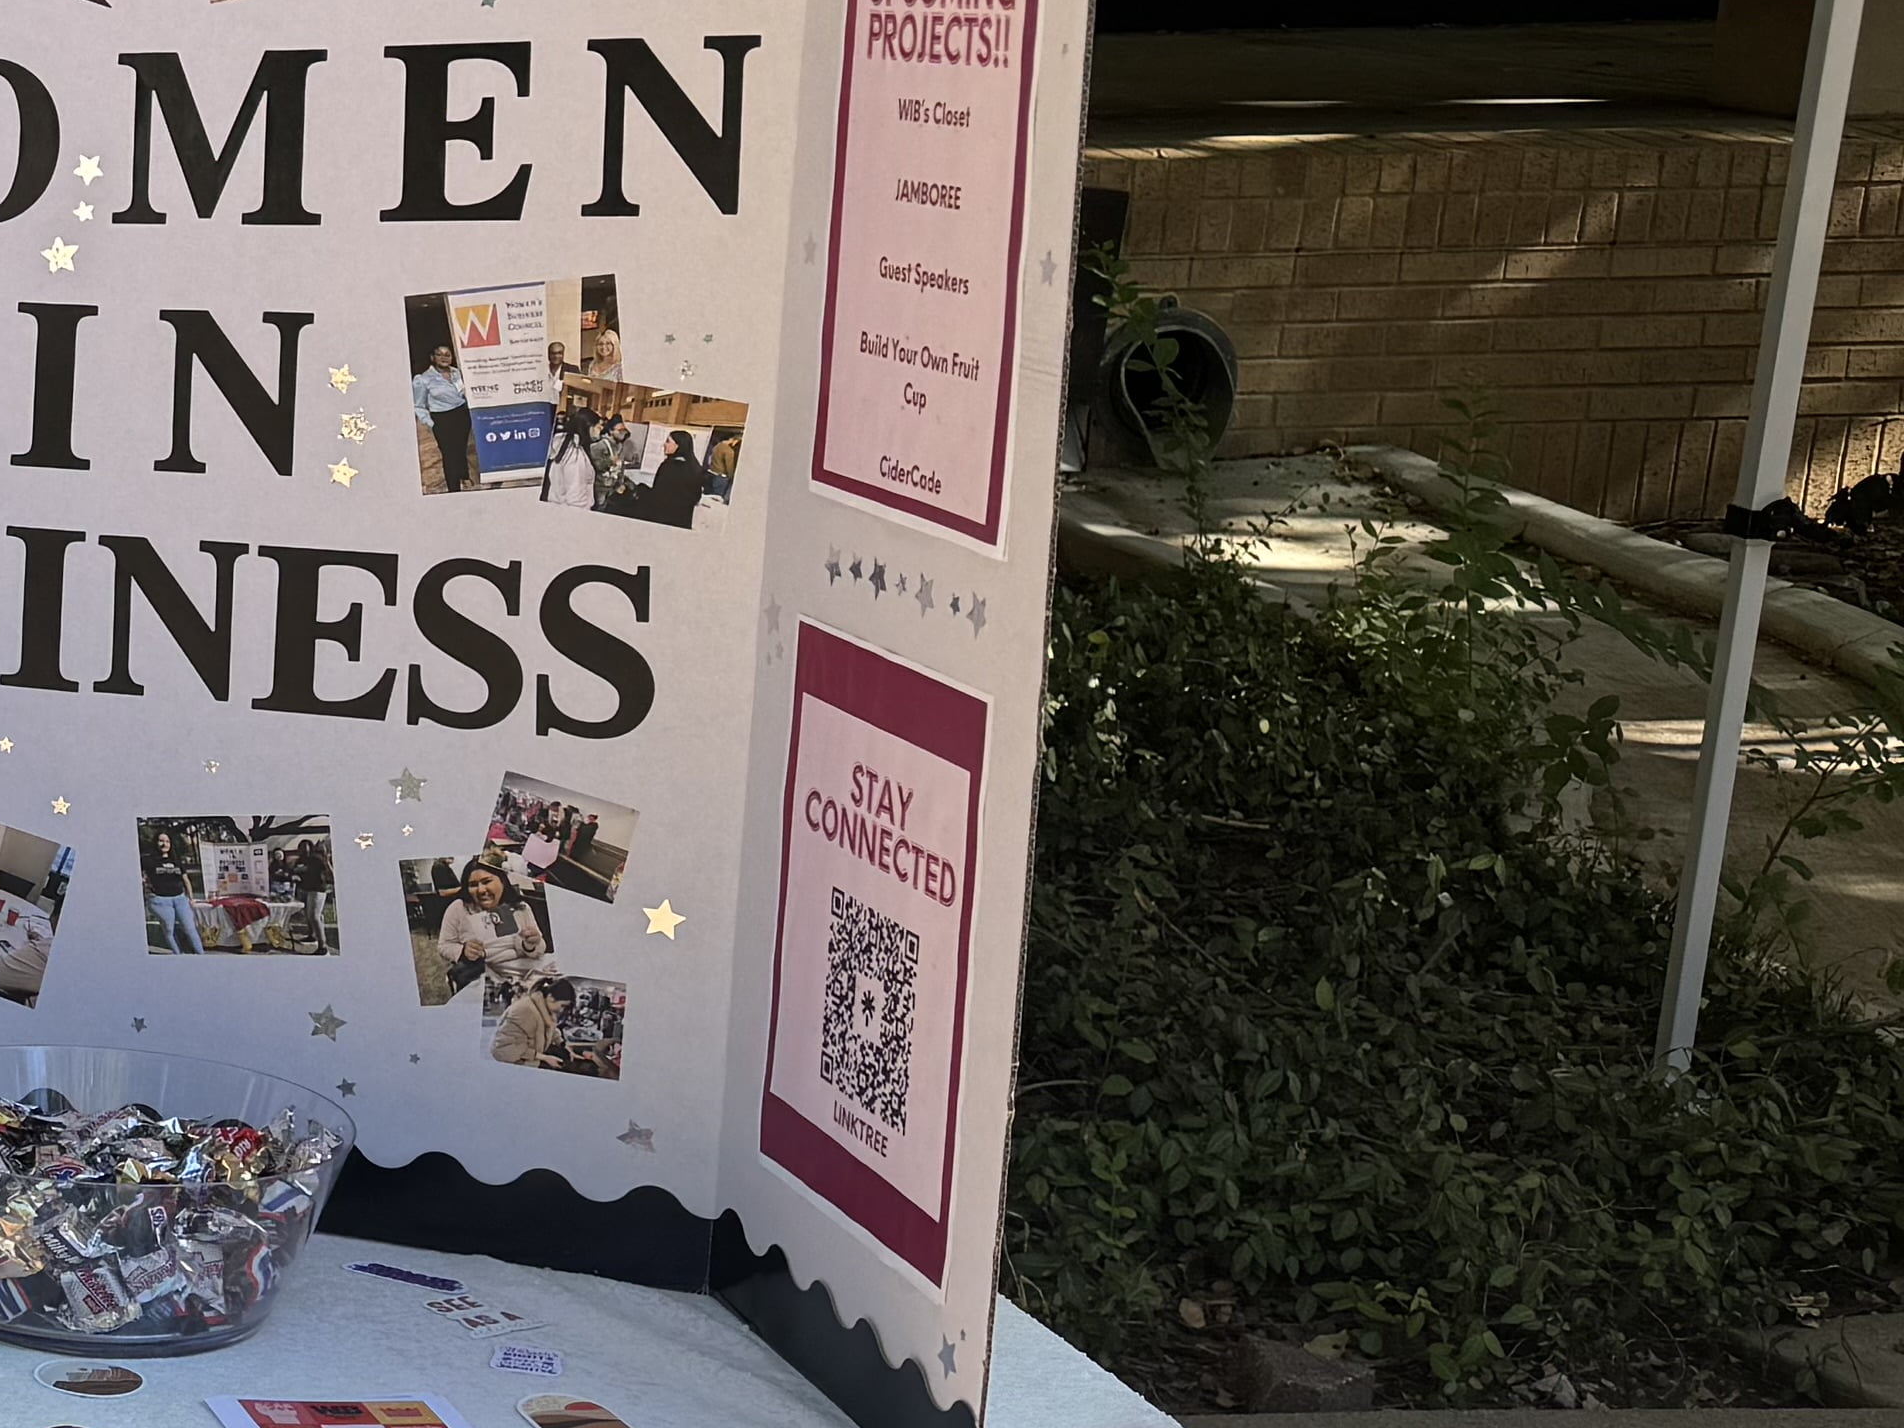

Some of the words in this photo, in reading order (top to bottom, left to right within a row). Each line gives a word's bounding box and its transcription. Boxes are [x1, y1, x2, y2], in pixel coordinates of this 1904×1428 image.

[867, 10, 1011, 68] PROJECTS!!
[898, 97, 930, 123] WIB's
[933, 102, 970, 128] Closet
[896, 178, 961, 210] JAMBOREE
[879, 256, 912, 280] Guest
[914, 263, 969, 295] Speakers
[860, 331, 888, 358] Build
[892, 338, 918, 365] Your
[921, 346, 948, 373] Own
[952, 353, 979, 380] Fruit
[10, 301, 314, 476] IN
[904, 382, 927, 414] Cup
[880, 456, 942, 494] CiderCade
[851, 761, 914, 831] STAY
[805, 787, 956, 907] CONNECTED
[833, 1100, 889, 1157] LINKTREE
[427, 1295, 483, 1313] SEE
[461, 1315, 500, 1329] AS
[500, 1311, 525, 1322] A
